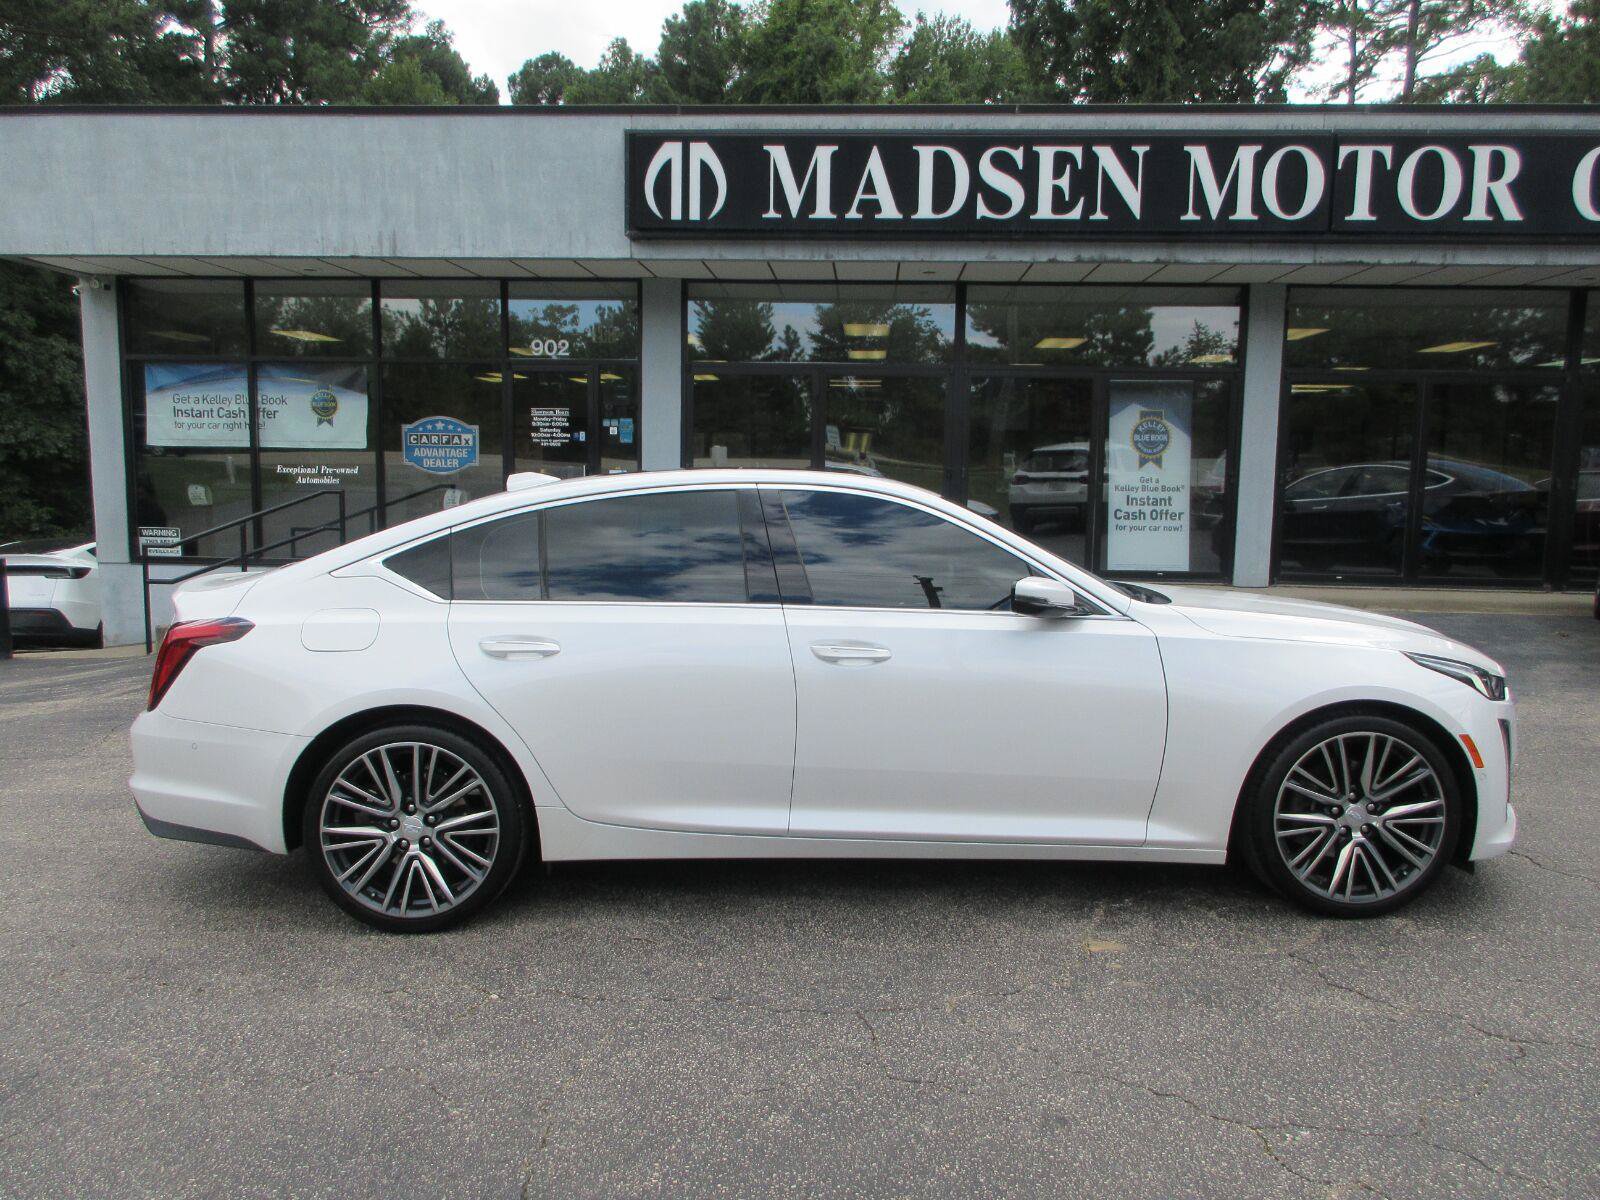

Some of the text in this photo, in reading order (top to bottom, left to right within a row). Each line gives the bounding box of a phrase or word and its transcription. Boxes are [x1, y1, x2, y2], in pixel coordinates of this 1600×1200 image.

[761, 144, 1151, 221] MADSEN
[1180, 144, 1525, 222] MOTOR
[530, 339, 570, 357] 902
[172, 393, 288, 406] Get a Kelley Blu Book
[172, 406, 280, 419] Instant Cash ffer
[174, 421, 185, 430] for
[187, 421, 206, 431] your
[207, 422, 221, 430] car
[222, 421, 242, 432] right
[409, 433, 472, 446] CARFAX
[413, 447, 469, 458] ADVANTAGE
[423, 458, 459, 468] DEALER
[276, 464, 359, 474] Exceptional Pre-owned
[296, 476, 340, 485] Automobiles
[1139, 476, 1153, 484] Get
[1114, 485, 1140, 493] Kelley
[1126, 494, 1173, 507] Instant
[1113, 508, 1185, 521] Cash Offer
[141, 529, 177, 537] WARNING
[1115, 523, 1128, 532] for
[1129, 524, 1147, 533] your
[1163, 524, 1183, 532] now!
